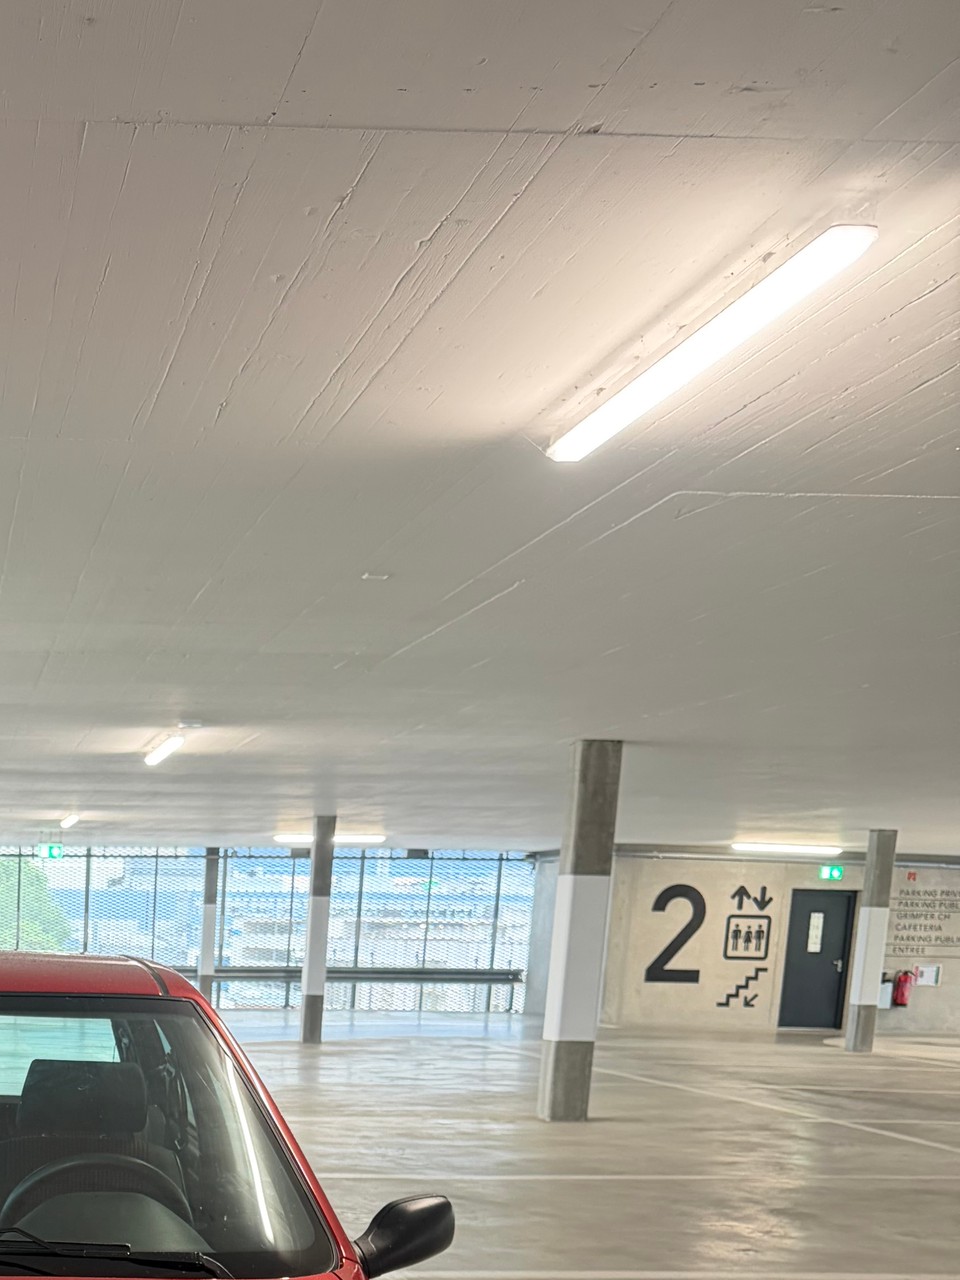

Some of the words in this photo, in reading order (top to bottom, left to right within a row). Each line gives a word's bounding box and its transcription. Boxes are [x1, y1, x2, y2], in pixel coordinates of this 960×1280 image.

[899, 889, 937, 897] PARKING
[898, 901, 936, 909] PARKING
[895, 923, 942, 932] CAFETERIA
[645, 884, 706, 983] 2
[893, 934, 932, 943] PARKING
